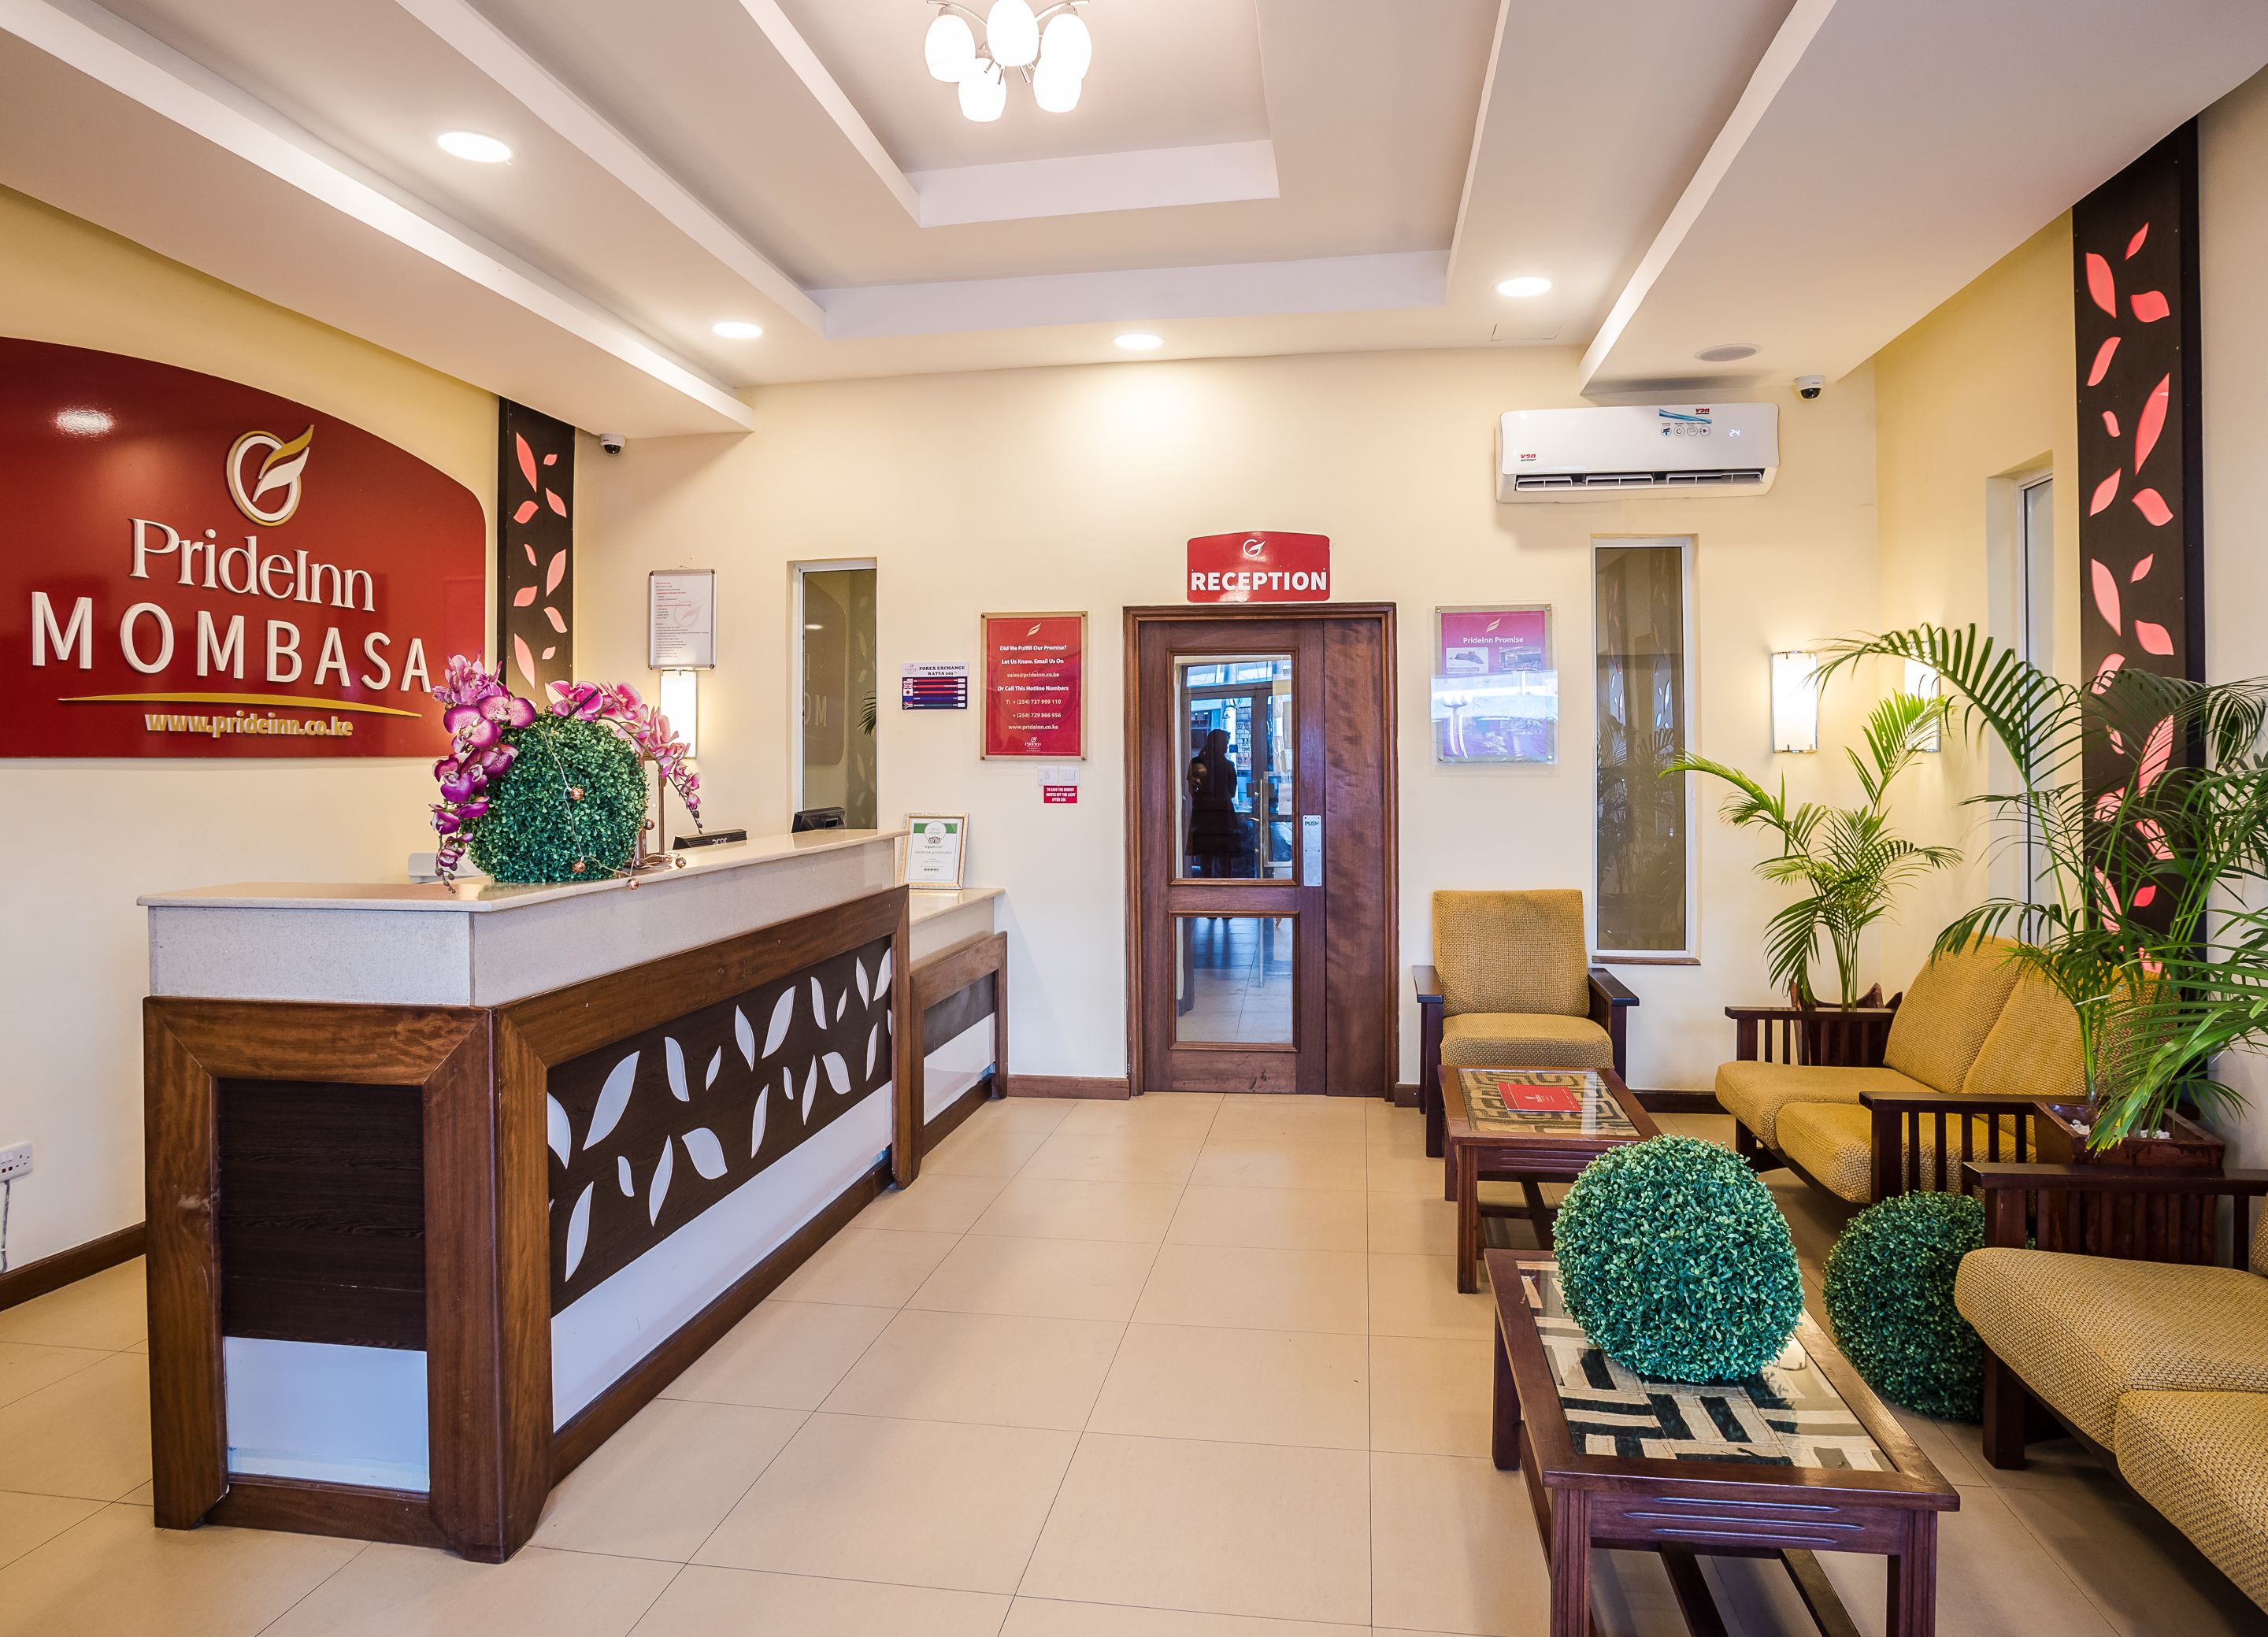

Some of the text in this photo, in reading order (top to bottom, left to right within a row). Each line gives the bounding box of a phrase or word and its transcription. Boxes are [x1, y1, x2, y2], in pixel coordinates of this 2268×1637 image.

[1729, 428, 1740, 437] 24
[129, 517, 376, 613] PrideInn
[1191, 571, 1327, 591] RECEPTION
[32, 591, 432, 692] MOMBASA
[145, 709, 354, 738] www.prideinn.co.ke
